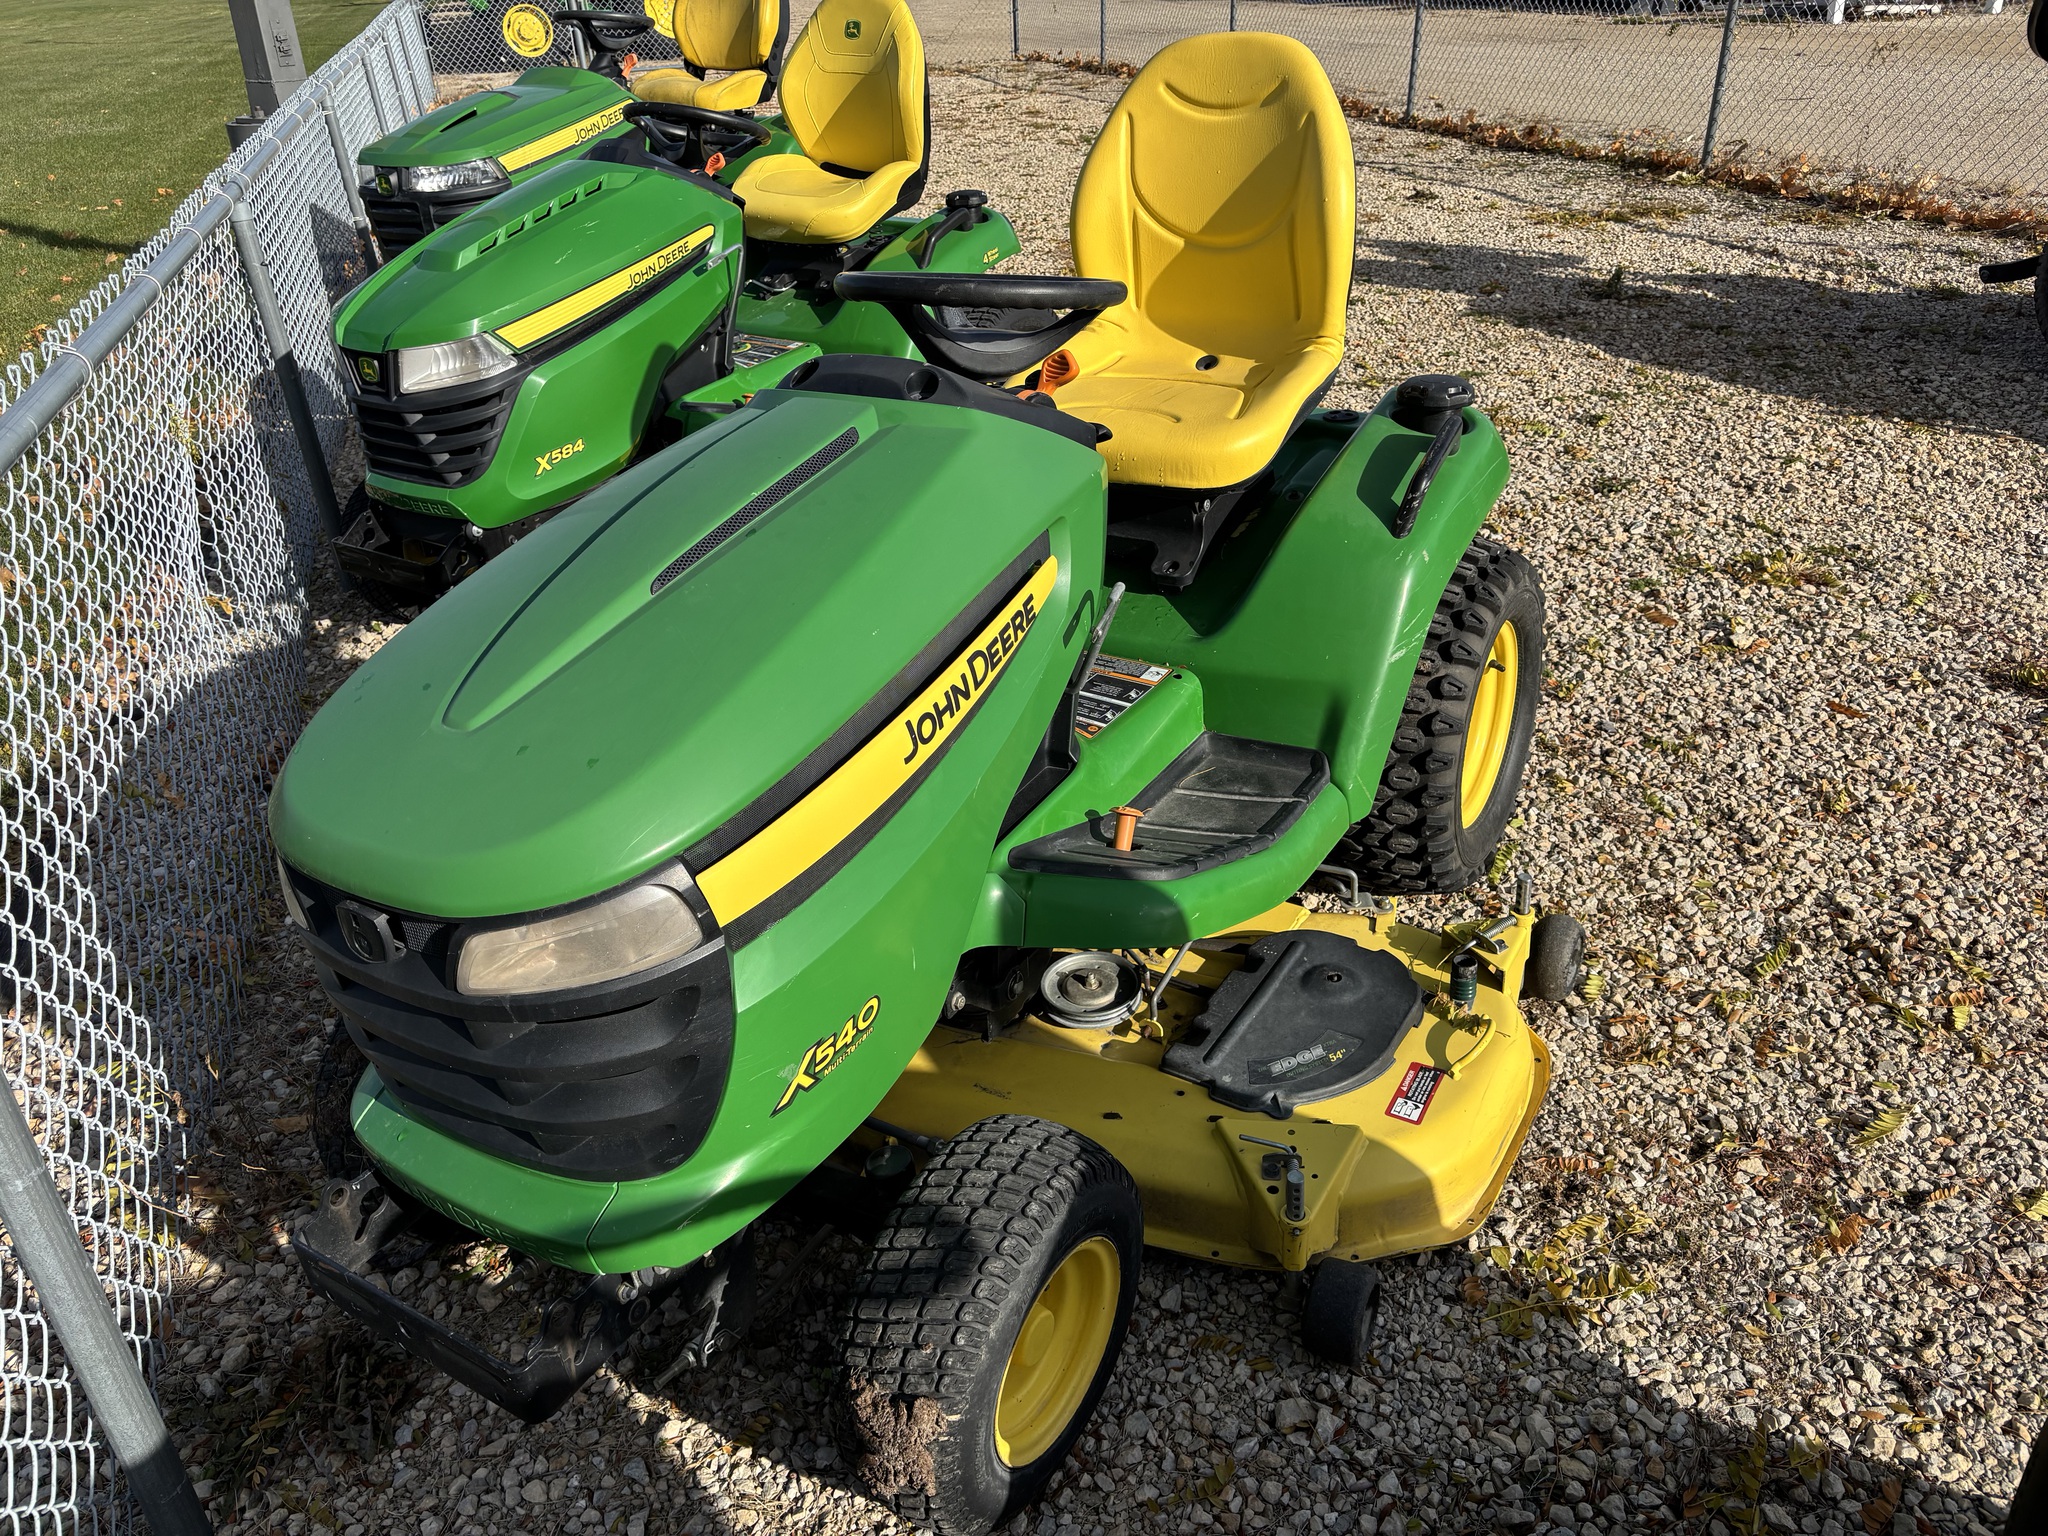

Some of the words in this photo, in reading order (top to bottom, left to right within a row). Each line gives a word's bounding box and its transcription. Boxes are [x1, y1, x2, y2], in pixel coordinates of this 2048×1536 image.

[575, 120, 601, 144] JOHN
[600, 107, 623, 129] DEER
[627, 262, 657, 290] JOHN
[656, 240, 691, 270] DEERE
[533, 437, 585, 478] X584
[904, 672, 970, 765] JOHN
[966, 594, 1037, 692] DEERE
[769, 994, 881, 1118] X540
[823, 1026, 874, 1077] Multi-Terrain
[1267, 1043, 1327, 1077] EDGE
[1328, 1047, 1347, 1063] 54"
[1402, 1070, 1415, 1087] DANGER
